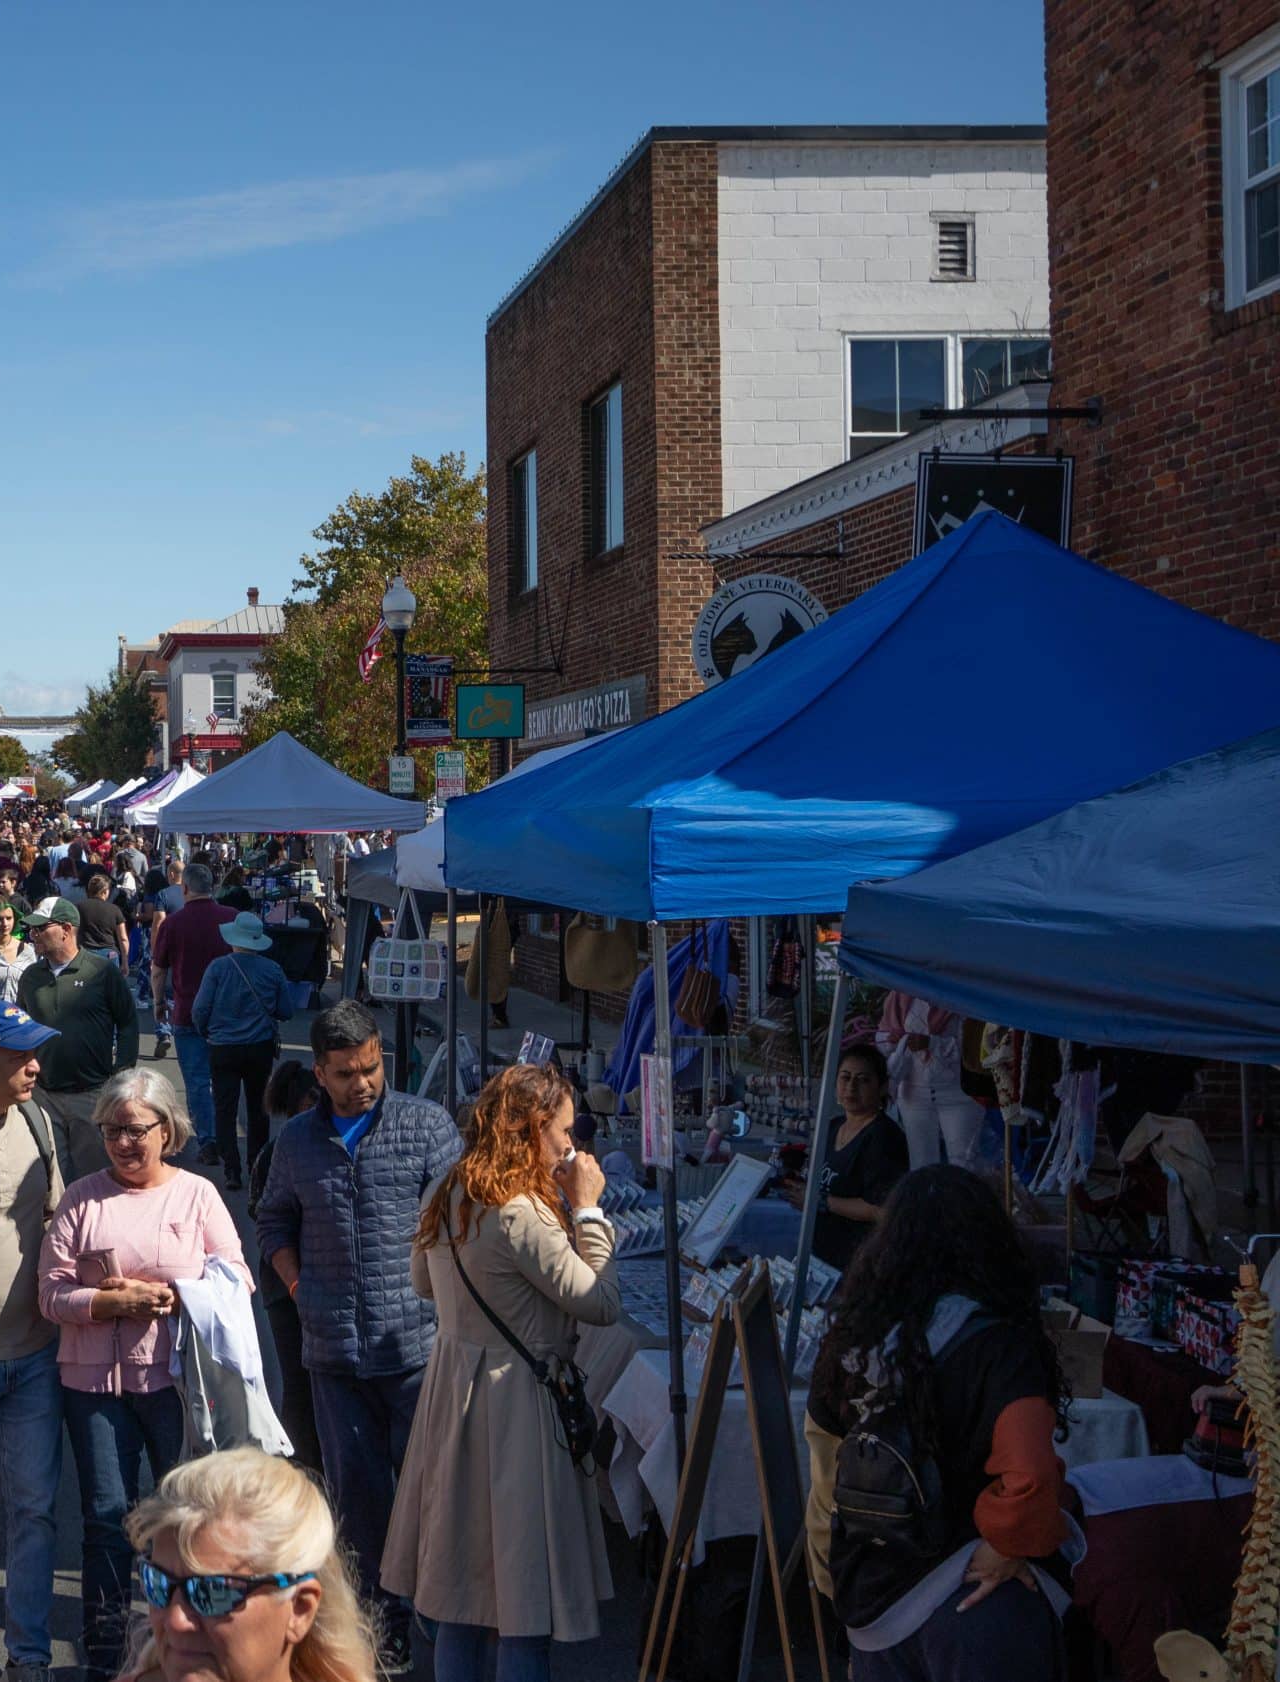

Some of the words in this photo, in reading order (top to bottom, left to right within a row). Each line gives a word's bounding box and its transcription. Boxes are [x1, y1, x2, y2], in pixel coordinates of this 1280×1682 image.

[702, 586, 737, 625] TOWNE
[738, 578, 818, 610] VETERINARY
[698, 630, 709, 657] OLD
[528, 707, 551, 740] BENNY
[604, 688, 631, 725] PIZZA
[438, 753, 444, 765] 2
